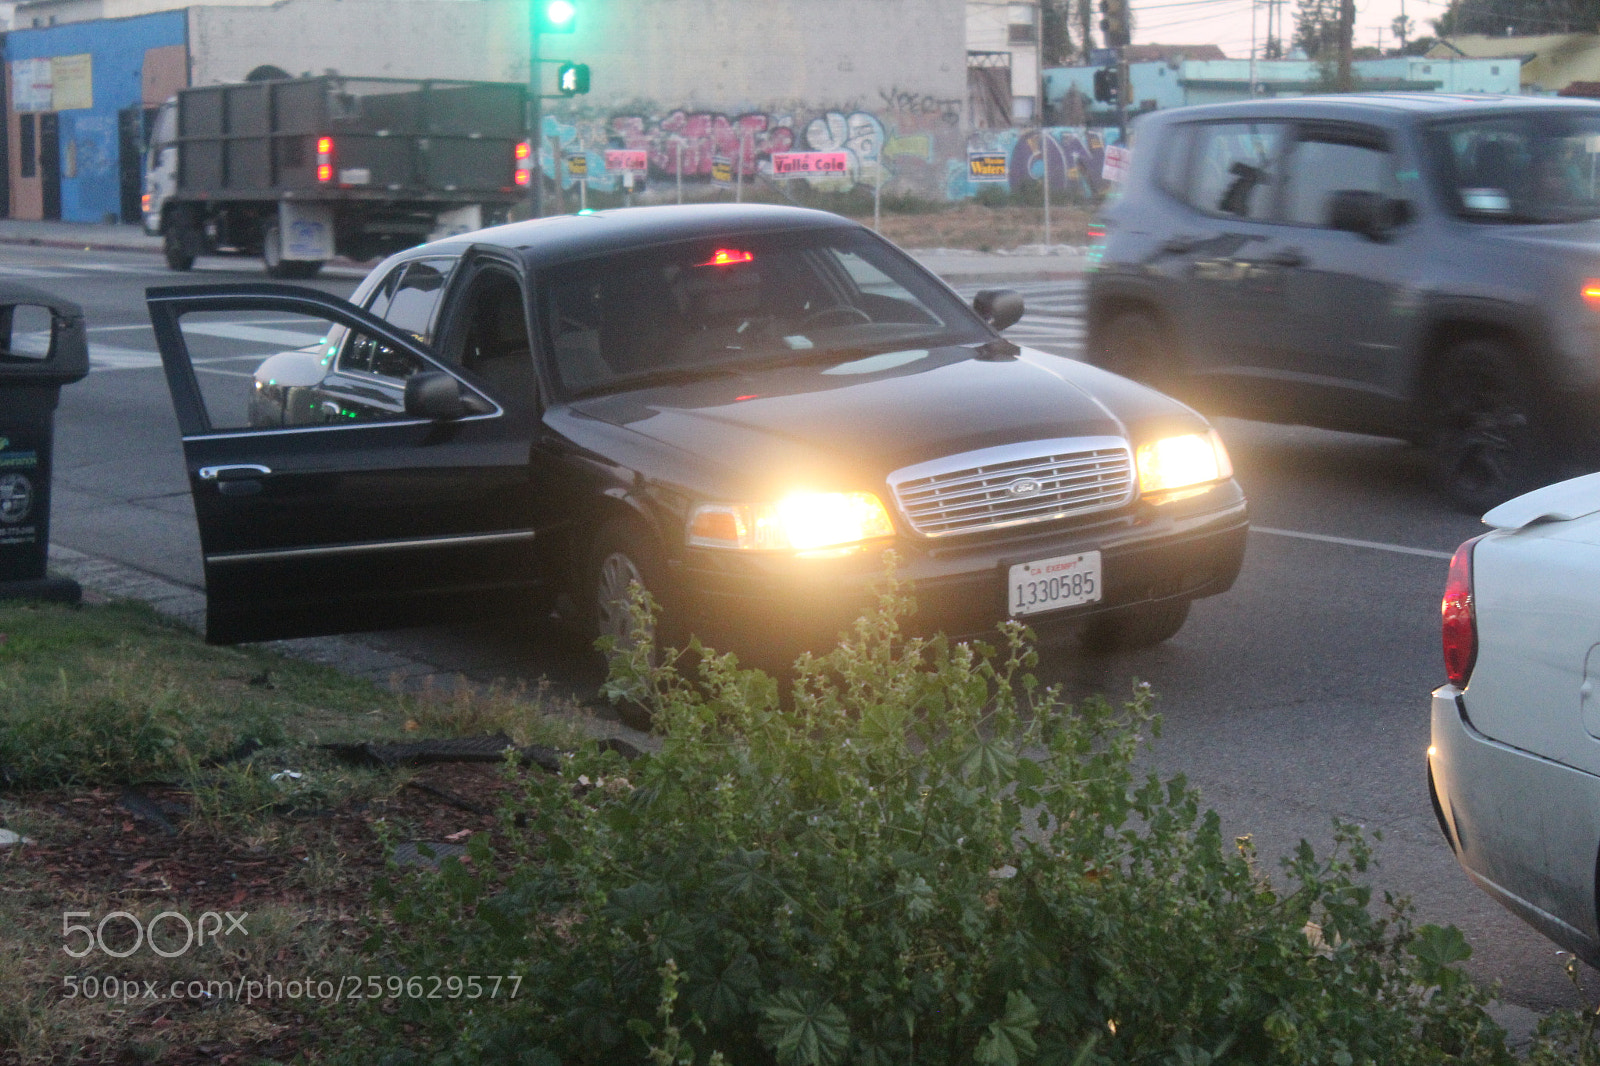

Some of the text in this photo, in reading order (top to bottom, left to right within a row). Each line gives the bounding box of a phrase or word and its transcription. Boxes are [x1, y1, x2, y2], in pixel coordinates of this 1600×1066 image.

[1030, 561, 1078, 576] CA EXEMPT
[1015, 571, 1095, 608] 1330585
